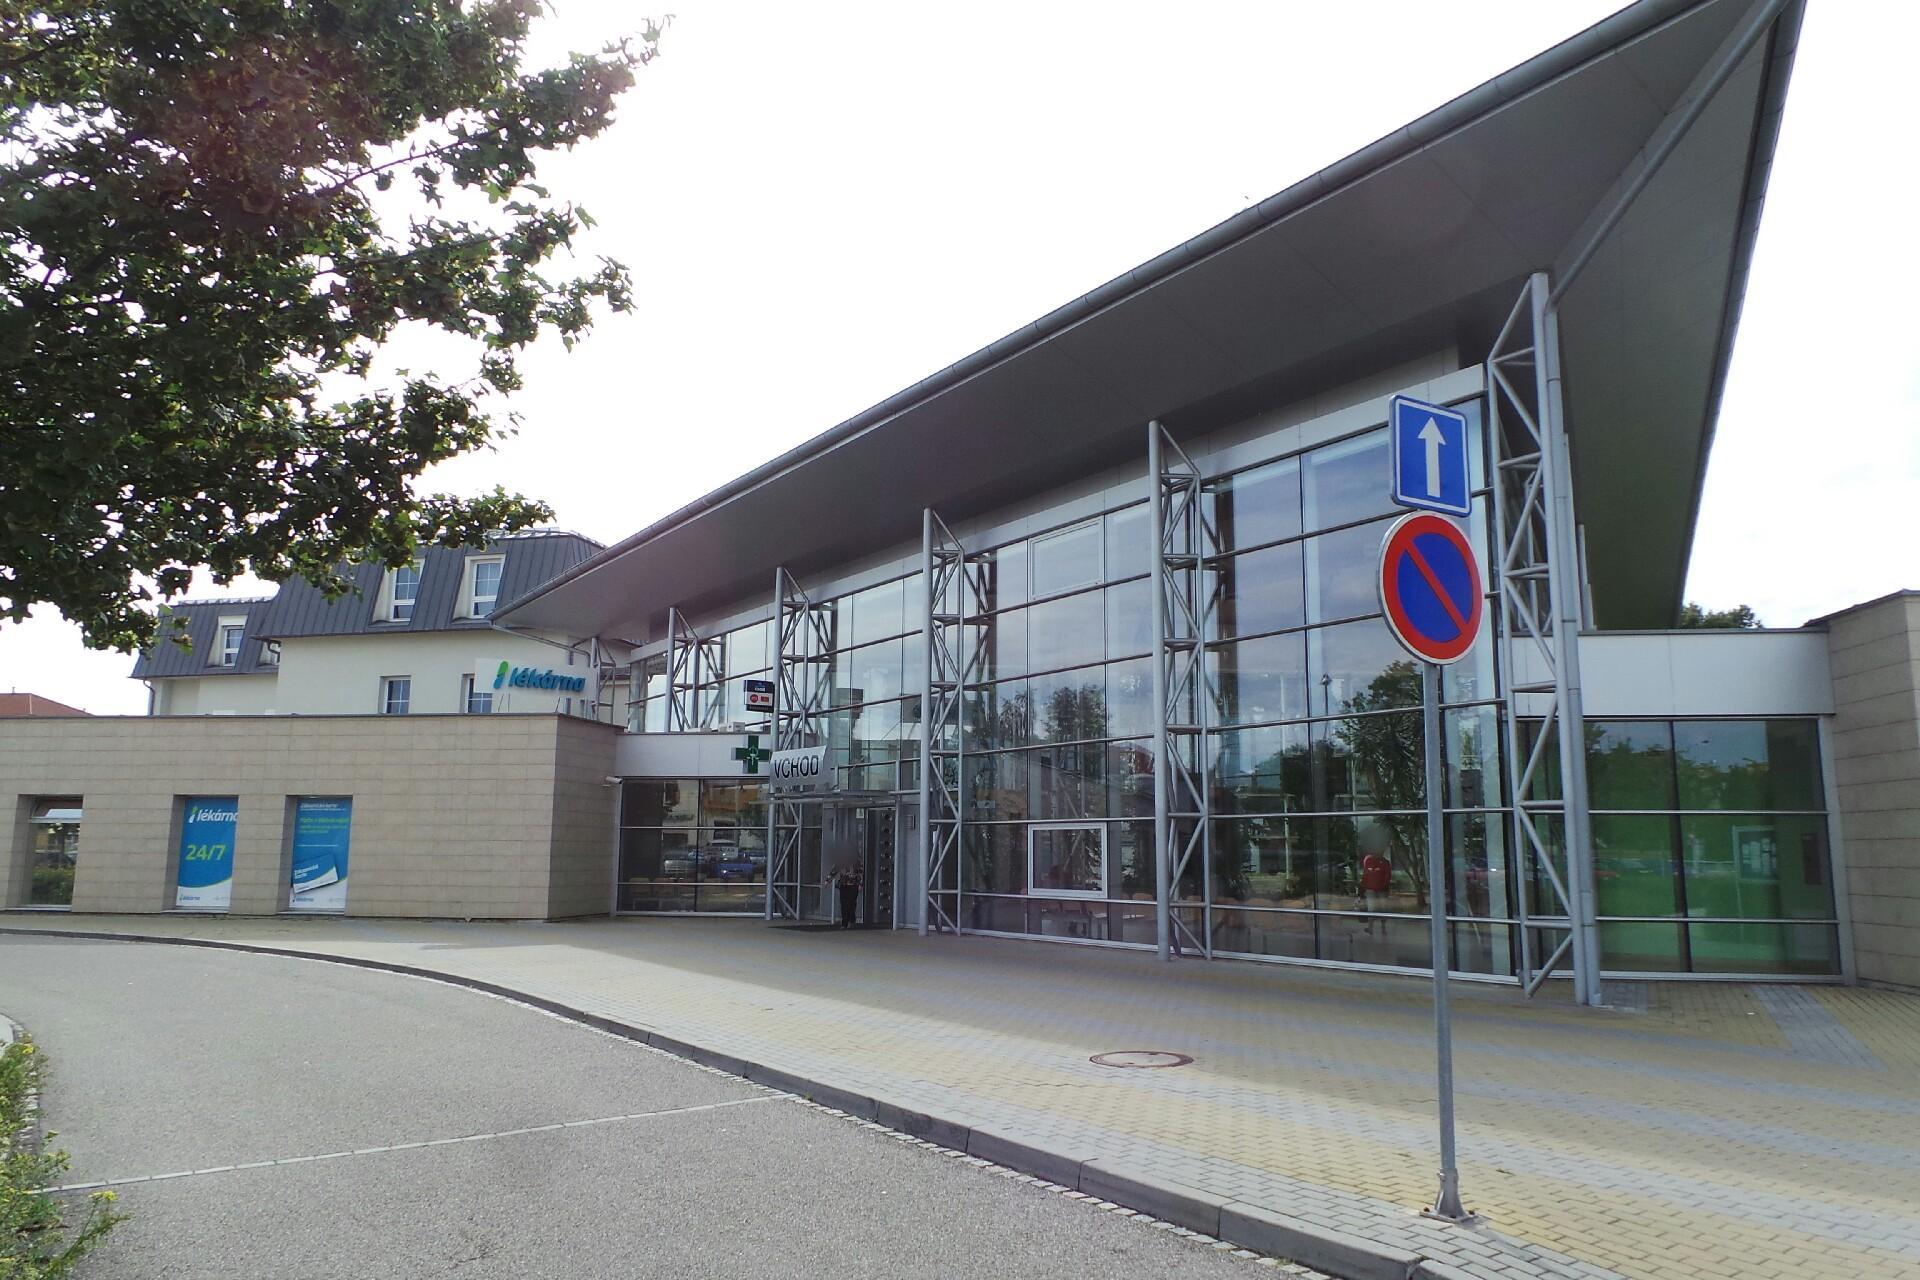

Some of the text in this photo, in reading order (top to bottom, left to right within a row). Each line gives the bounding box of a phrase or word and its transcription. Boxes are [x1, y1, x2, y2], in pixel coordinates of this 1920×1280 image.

[508, 667, 585, 692] lékárna
[774, 755, 819, 779] VCHOD
[186, 844, 226, 861] 24/7
